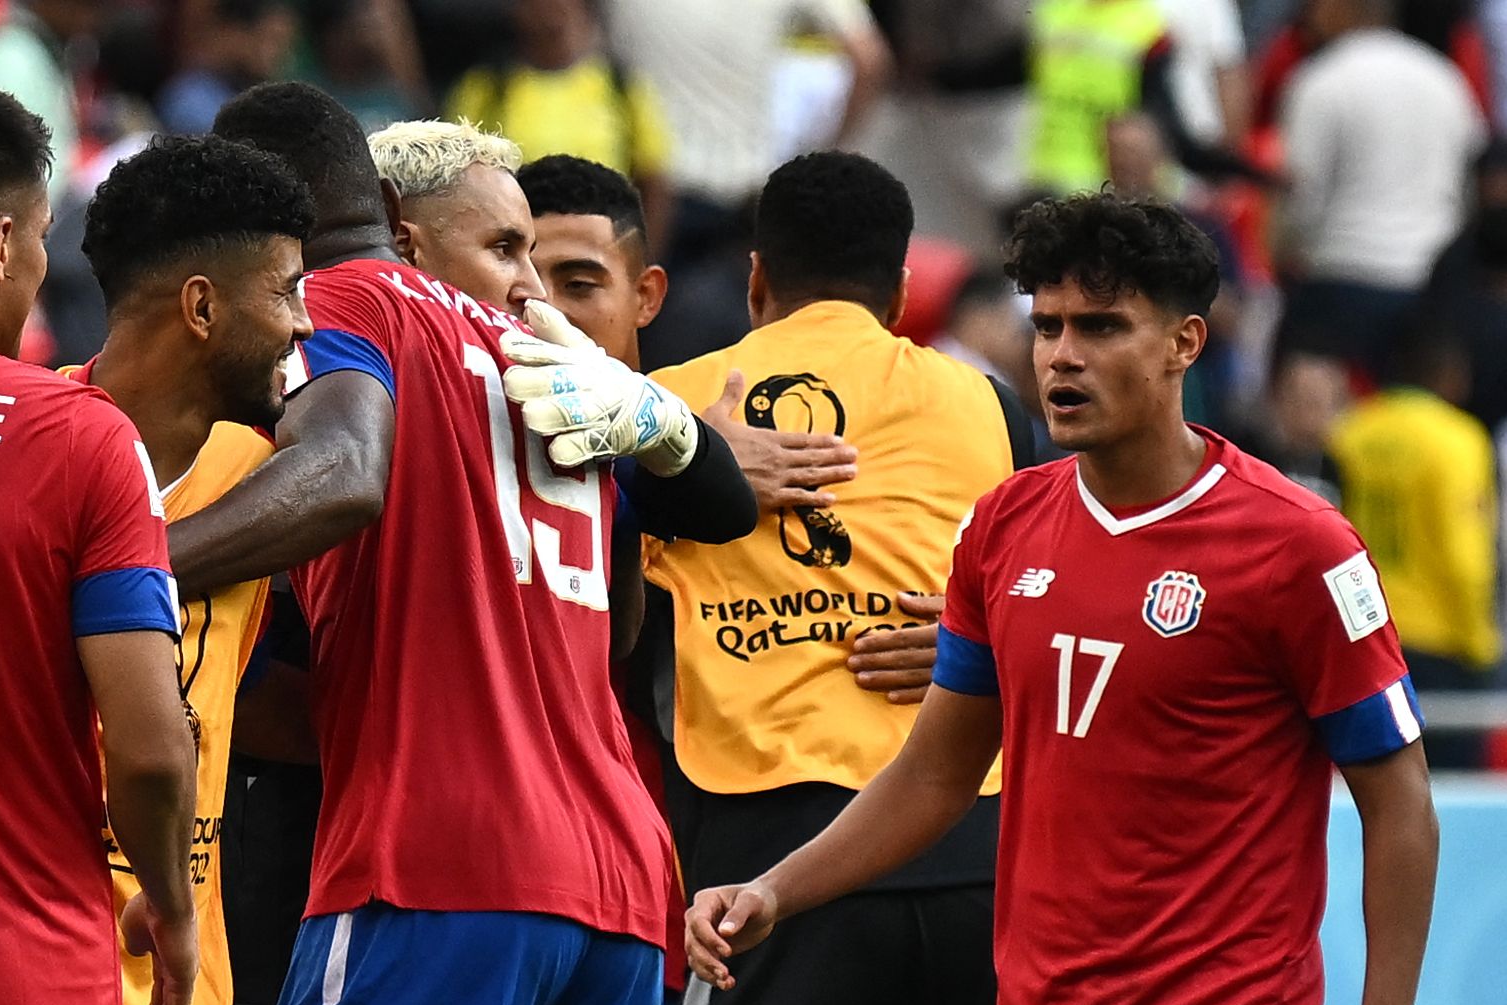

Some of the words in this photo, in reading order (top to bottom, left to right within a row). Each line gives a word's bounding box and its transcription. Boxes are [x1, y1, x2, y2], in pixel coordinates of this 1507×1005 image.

[463, 341, 609, 611] 19
[700, 598, 767, 623] FIFA
[769, 589, 891, 617] WORLD
[716, 620, 852, 662] Qatar
[1050, 632, 1125, 739] 17
